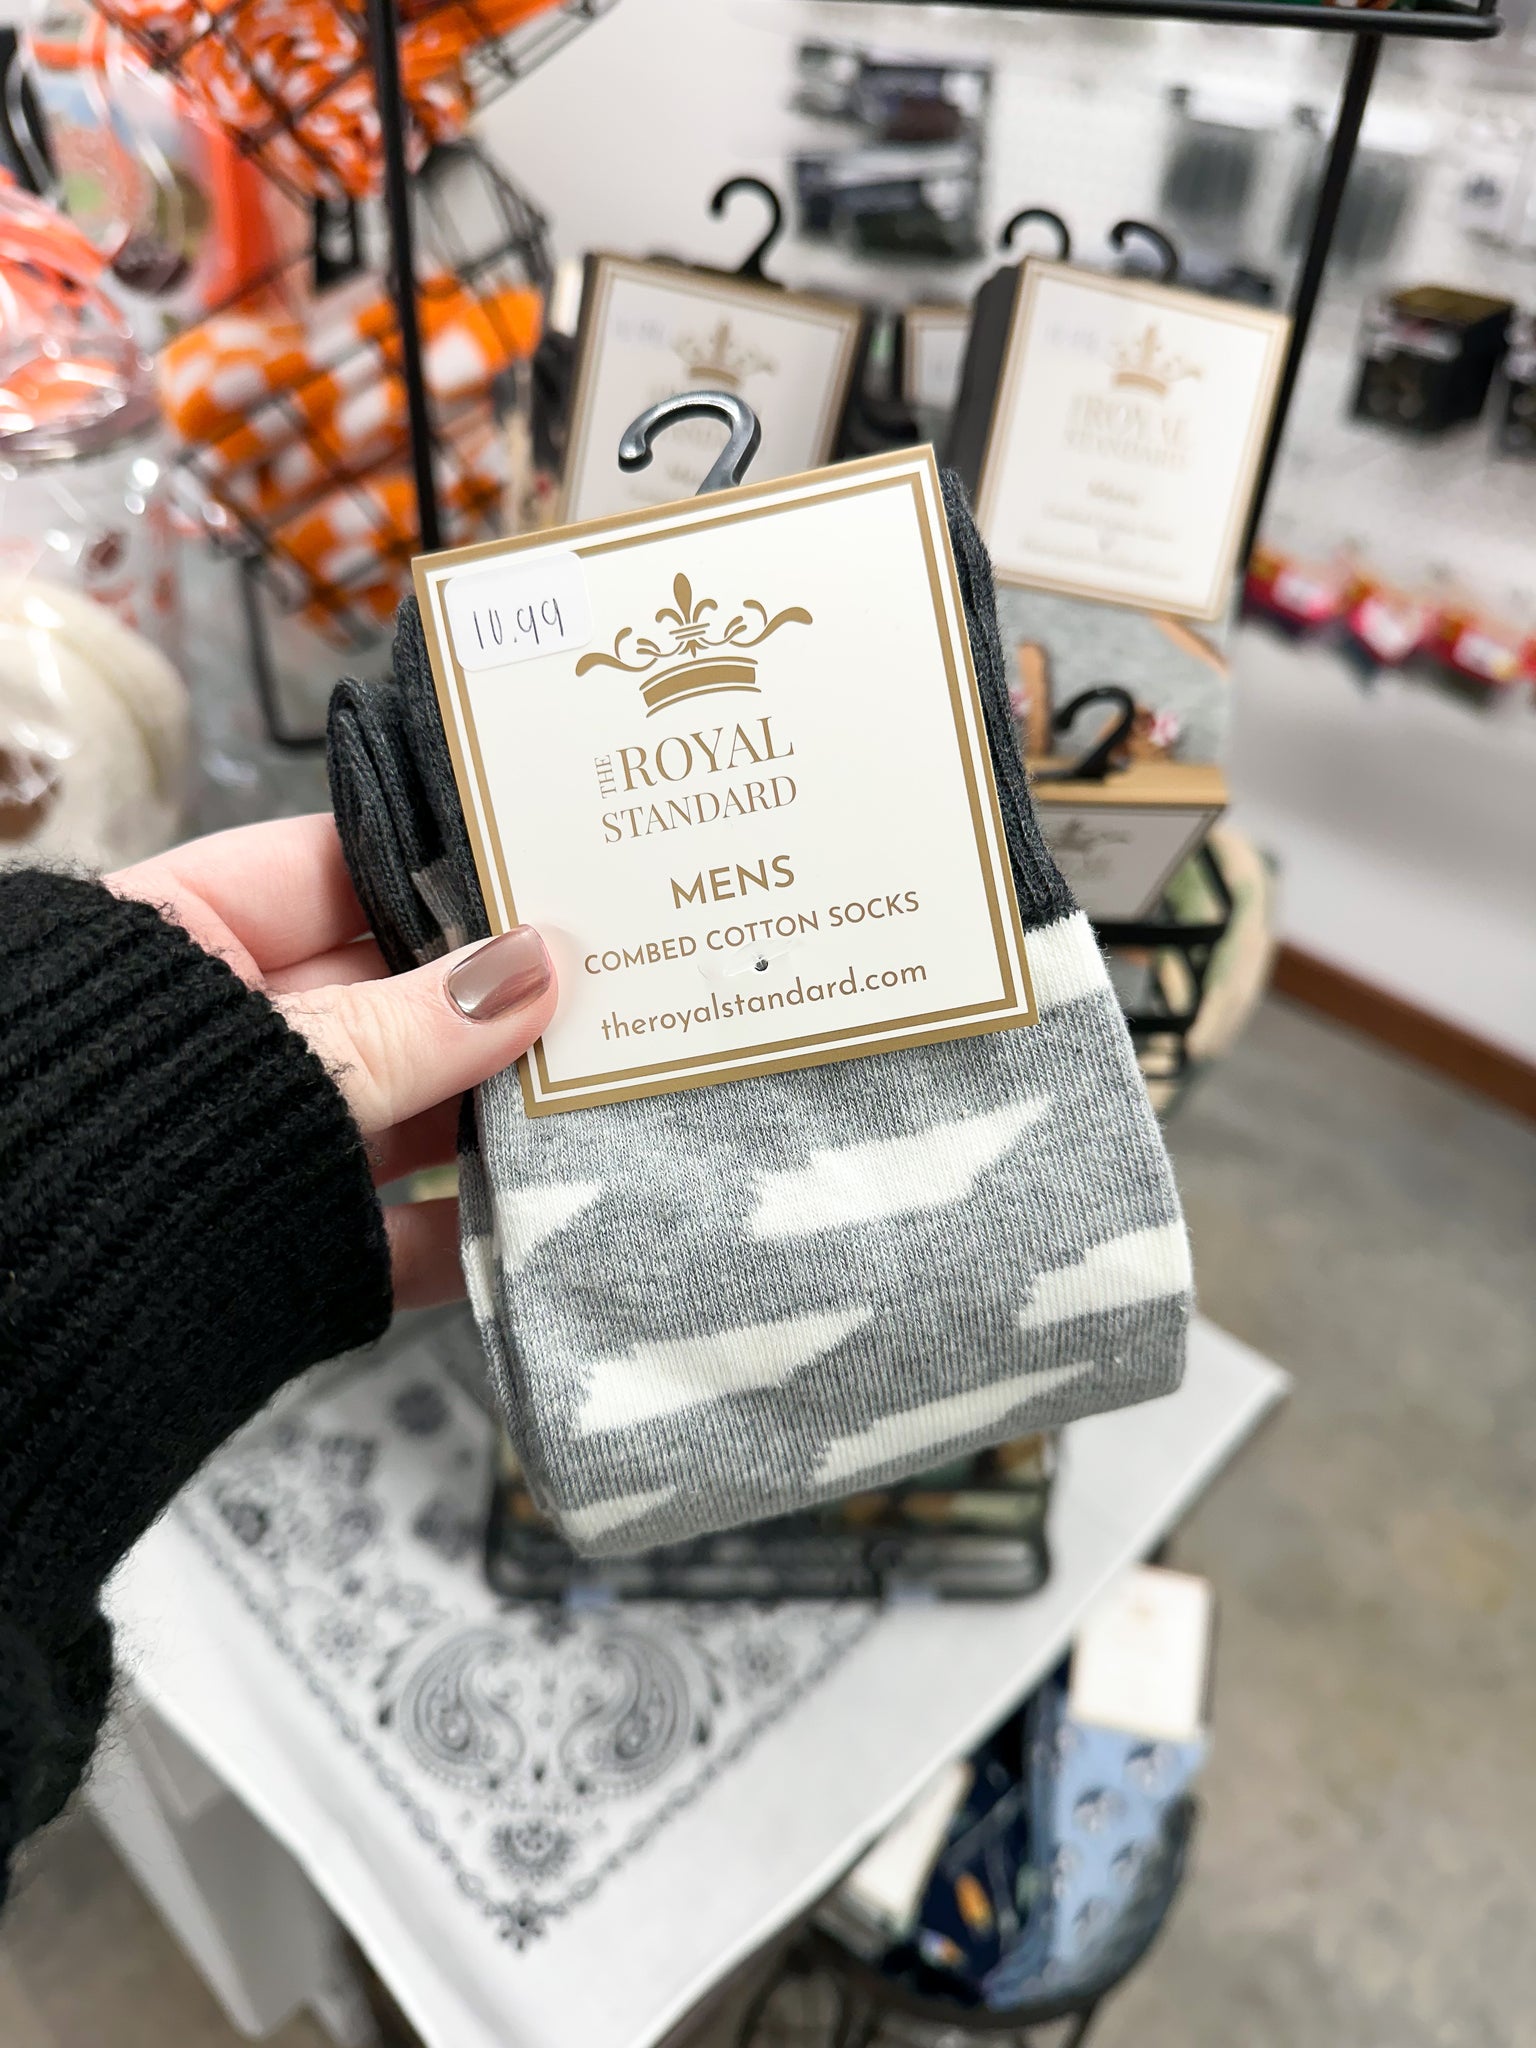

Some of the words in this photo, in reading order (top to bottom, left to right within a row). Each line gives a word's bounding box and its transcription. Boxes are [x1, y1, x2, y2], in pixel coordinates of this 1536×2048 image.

[473, 597, 565, 650] 10.99
[594, 753, 618, 800] THE
[616, 716, 795, 793] ROYAL
[601, 775, 798, 844] STANDARD
[671, 855, 796, 910] MENS
[584, 935, 697, 976] COMBED
[706, 911, 820, 952] COTTON
[828, 890, 921, 929] SOCKS
[600, 965, 928, 1042] theroyalstandard.com
